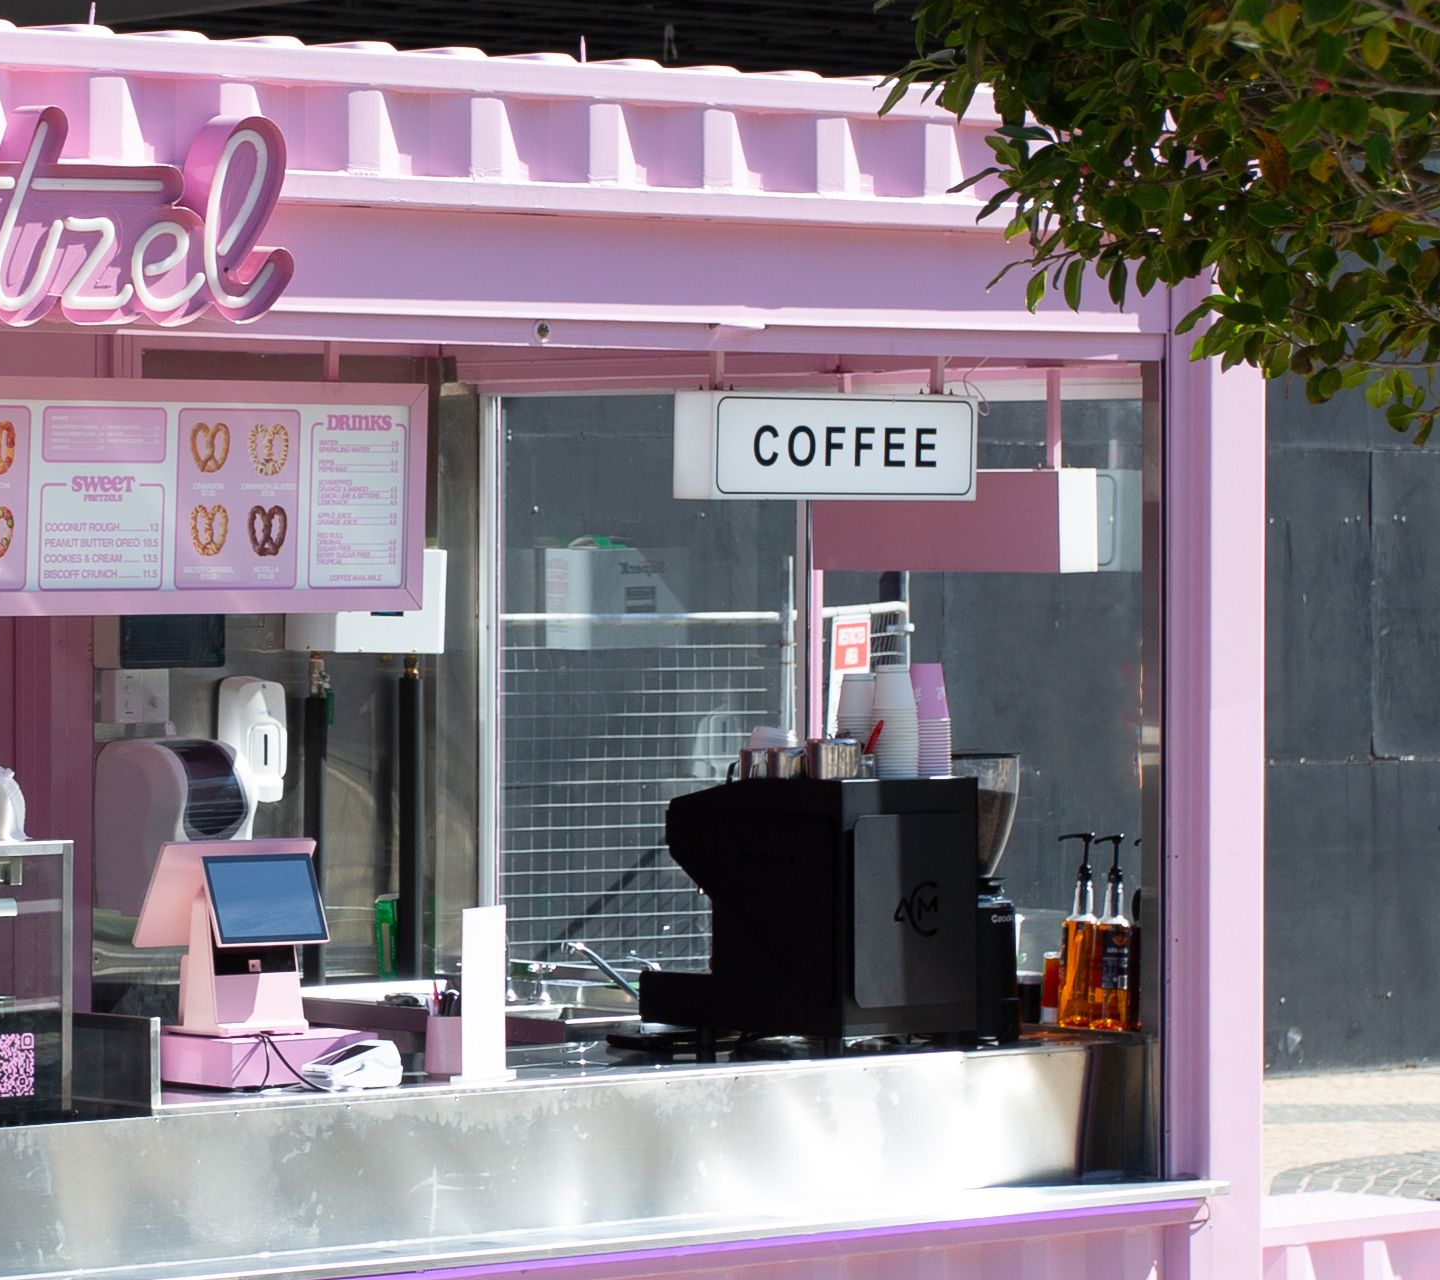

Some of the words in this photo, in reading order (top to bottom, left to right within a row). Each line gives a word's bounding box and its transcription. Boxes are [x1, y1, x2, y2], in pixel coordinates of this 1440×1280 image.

[752, 424, 939, 468] COFFEE
[44, 523, 87, 532] COCONUT
[88, 523, 120, 532] ROUGH
[149, 523, 159, 532] 13
[44, 538, 79, 548] PEANUT
[80, 538, 114, 548] BUTTER
[115, 538, 140, 548] OREO
[43, 554, 82, 563] COOKIES
[83, 554, 90, 563] &
[91, 554, 123, 563] CREAM
[142, 554, 158, 563] 13.5
[43, 569, 80, 579] BISCOFF
[81, 569, 118, 579] CRUNCH
[143, 569, 158, 579] 11.5
